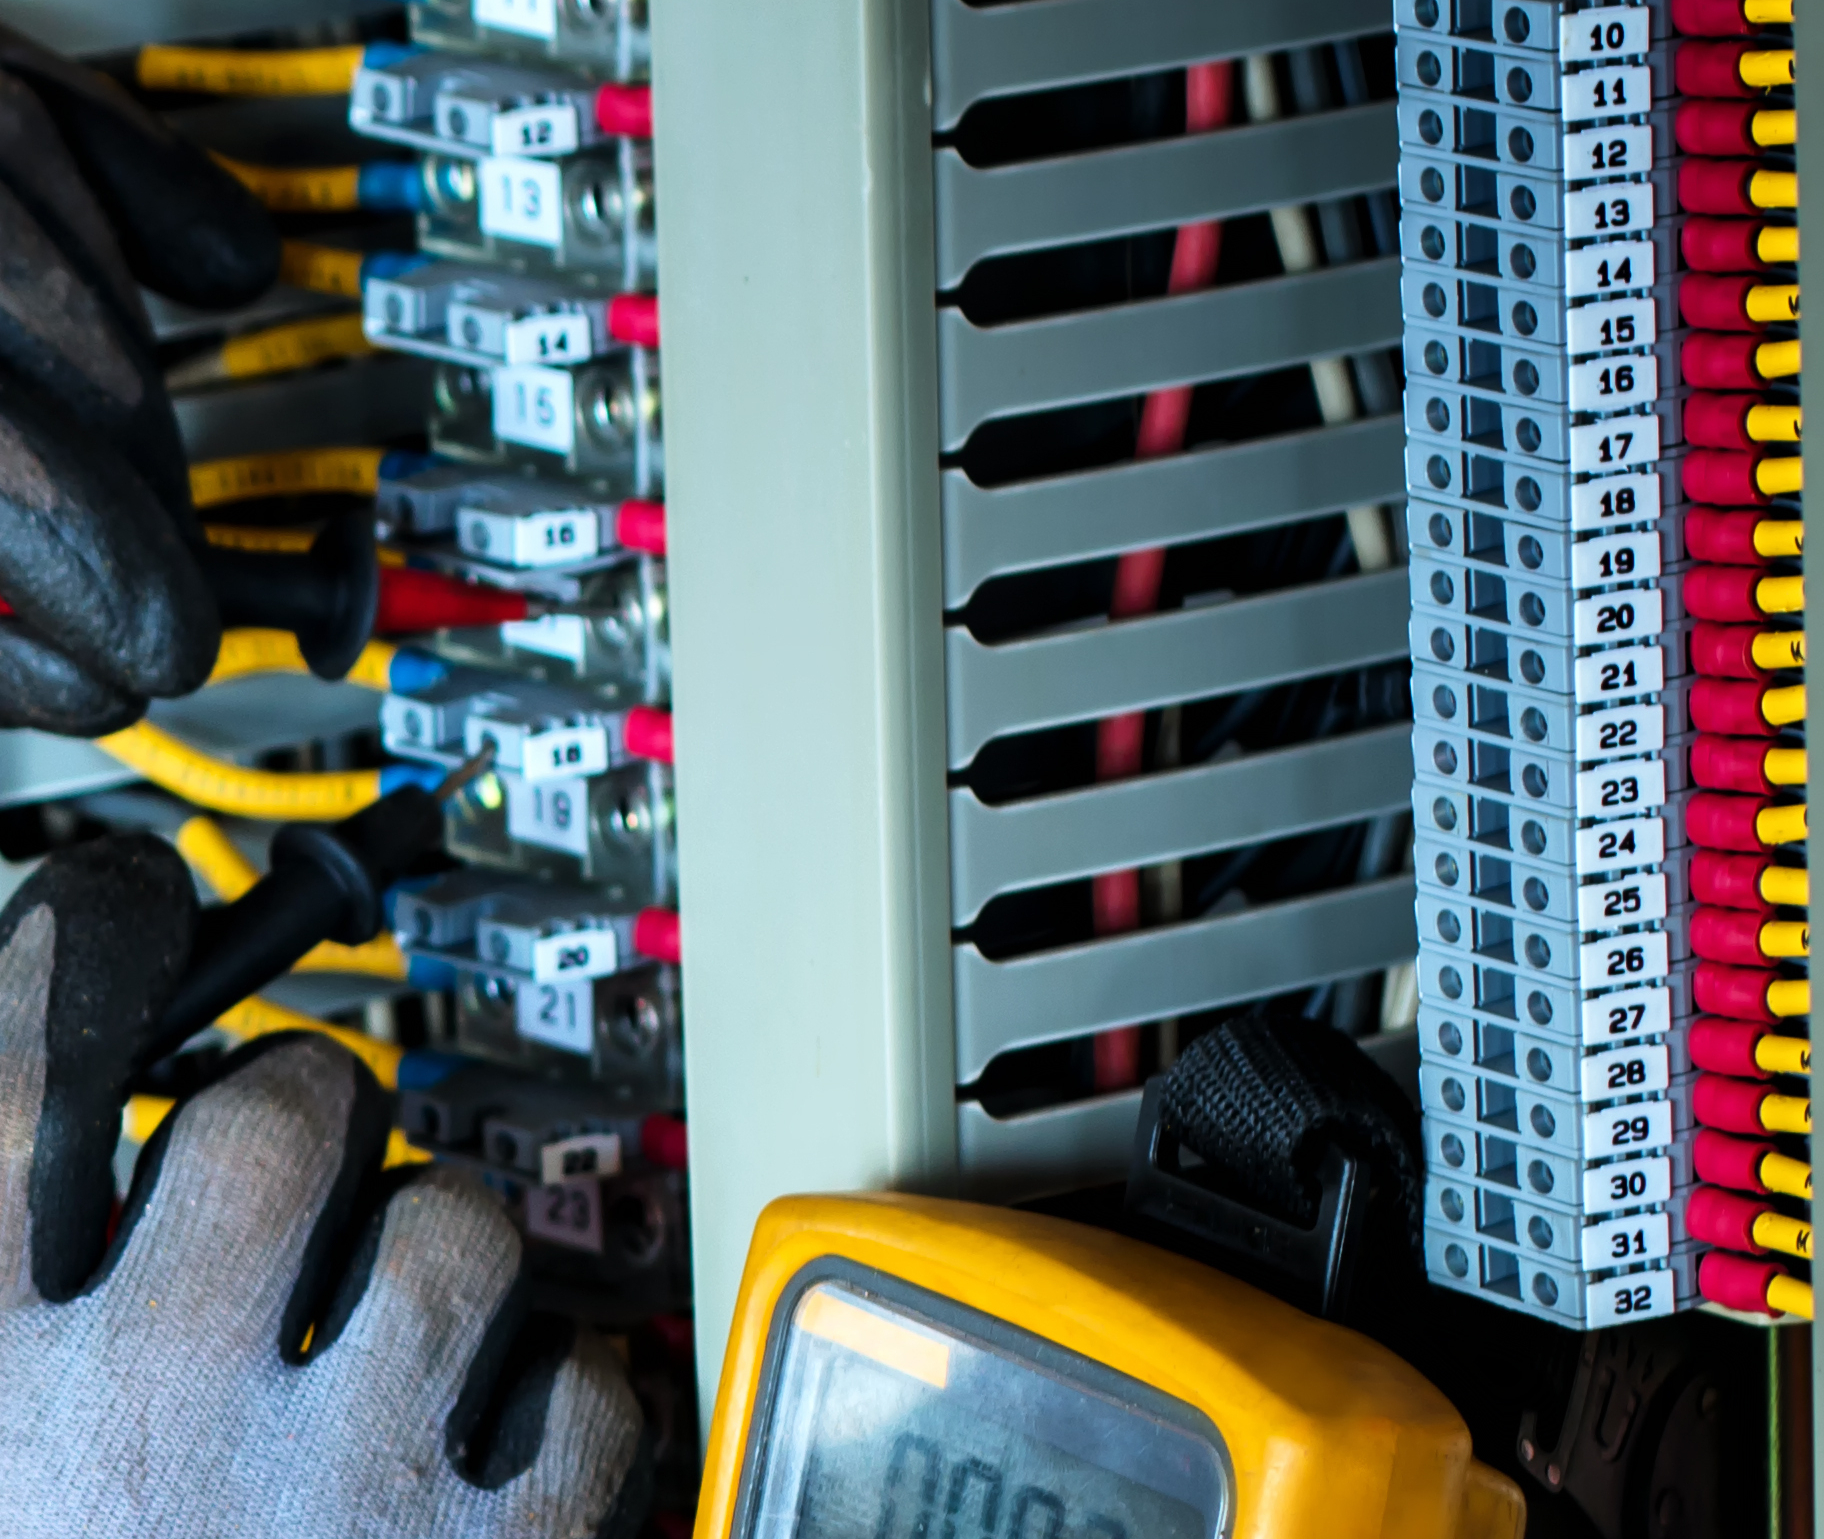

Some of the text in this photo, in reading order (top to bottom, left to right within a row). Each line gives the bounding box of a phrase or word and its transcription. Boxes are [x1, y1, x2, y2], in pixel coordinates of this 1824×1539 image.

[1590, 21, 1625, 52] 10
[1593, 77, 1627, 108] 11
[521, 119, 552, 147] 12
[1591, 139, 1628, 170] 12
[500, 174, 542, 220] 13
[1594, 198, 1631, 230] 13
[1597, 256, 1632, 288] 14
[538, 330, 568, 356] 14
[1600, 314, 1635, 346] 15
[1599, 364, 1635, 396] 16
[514, 381, 556, 428] 15
[1598, 432, 1634, 463] 17
[1599, 487, 1636, 518] 18
[1599, 547, 1635, 578] 19
[1596, 602, 1635, 634] 20
[1600, 660, 1638, 691] 21
[1599, 719, 1638, 750] 22
[1601, 776, 1639, 807] 23
[533, 785, 572, 830] 19
[1598, 828, 1636, 859] 24
[1603, 886, 1642, 917] 25
[1607, 946, 1645, 976] 26
[539, 984, 577, 1031] 21
[1608, 1003, 1646, 1035] 27
[1607, 1059, 1647, 1089] 28
[1611, 1115, 1650, 1146] 29
[1610, 1170, 1647, 1201] 30
[1611, 1228, 1648, 1259] 31
[1614, 1285, 1652, 1315] 32
